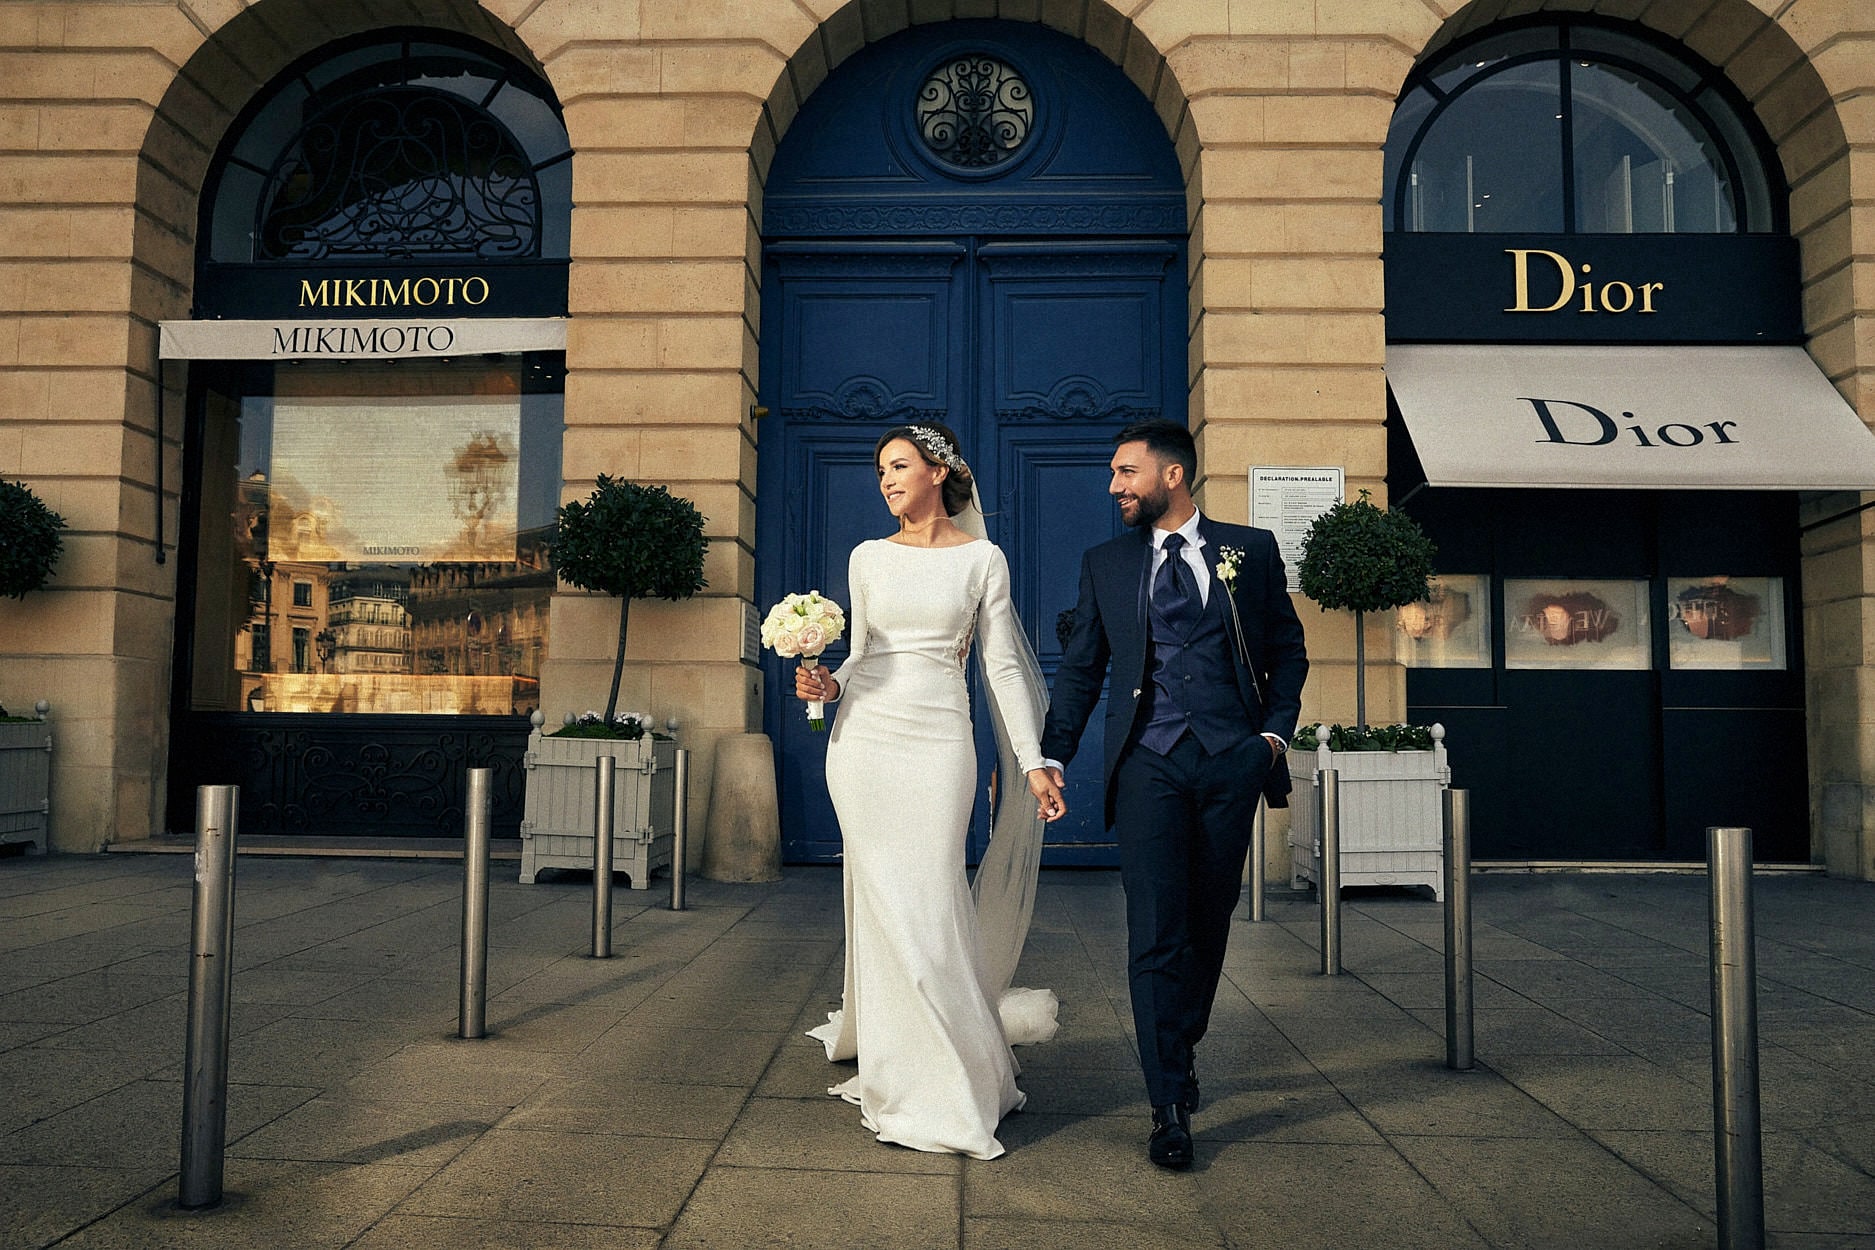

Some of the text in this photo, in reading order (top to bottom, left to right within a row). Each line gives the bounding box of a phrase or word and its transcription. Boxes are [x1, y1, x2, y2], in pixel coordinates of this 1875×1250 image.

[299, 276, 490, 307] MIKIMOTO
[1503, 249, 1664, 313] Dior
[272, 326, 455, 354] MIKIMOTO
[1516, 397, 1740, 447] Dior
[363, 546, 420, 556] MIKIMOTO
